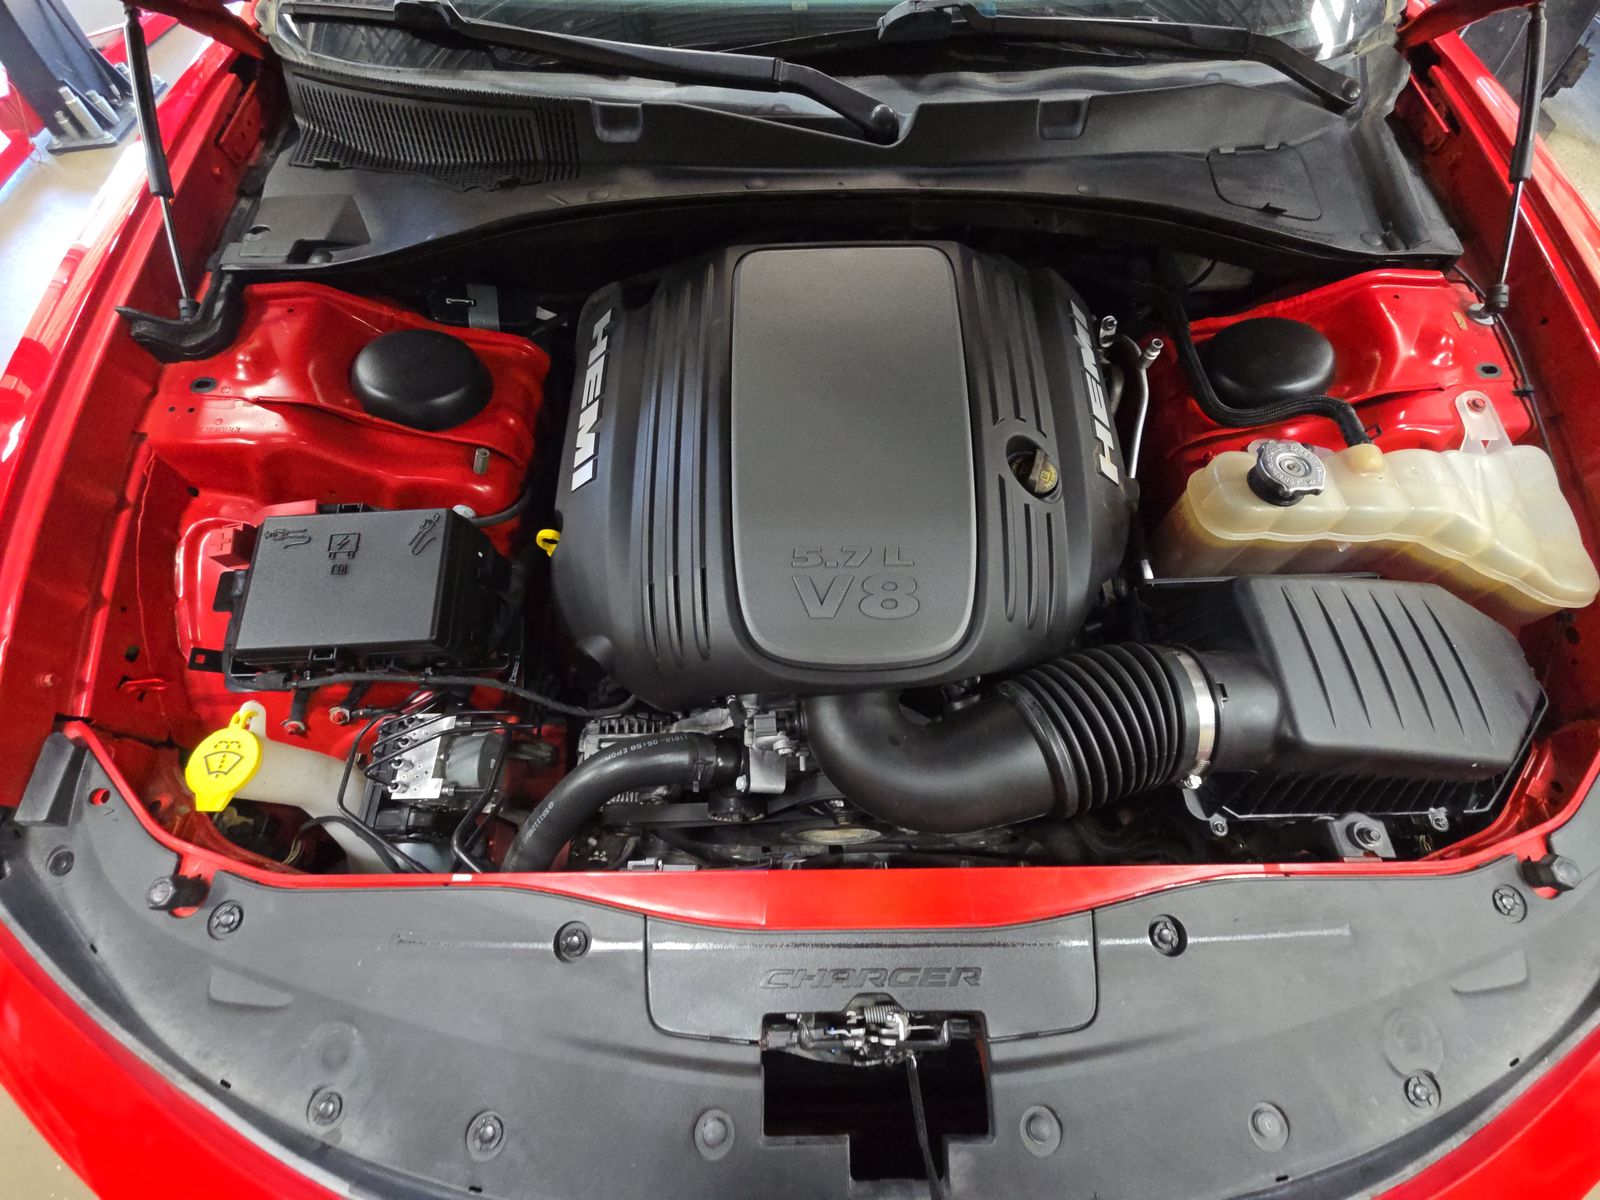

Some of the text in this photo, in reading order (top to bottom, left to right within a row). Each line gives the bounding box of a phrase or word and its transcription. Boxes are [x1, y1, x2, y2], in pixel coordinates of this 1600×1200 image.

[571, 308, 612, 492] HEMI
[1070, 300, 1120, 486] HEMI
[791, 573, 921, 620] V8
[759, 966, 983, 989] CHARGER
